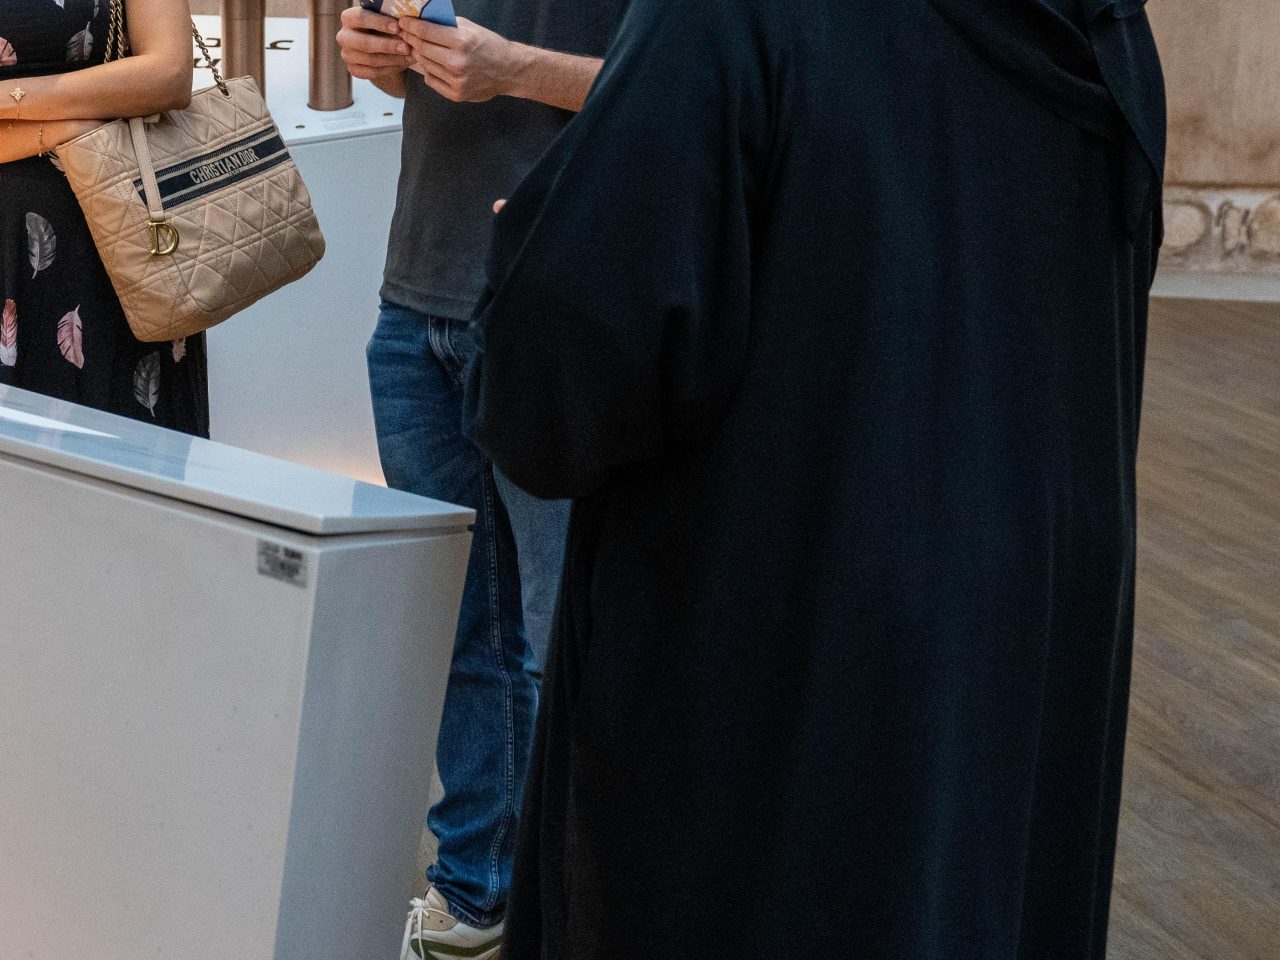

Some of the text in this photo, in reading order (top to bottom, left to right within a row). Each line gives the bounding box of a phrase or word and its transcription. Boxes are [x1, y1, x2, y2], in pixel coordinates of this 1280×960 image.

[189, 153, 242, 184] CHRISTIAN
[238, 147, 260, 166] DIOR
[148, 221, 179, 256] D
